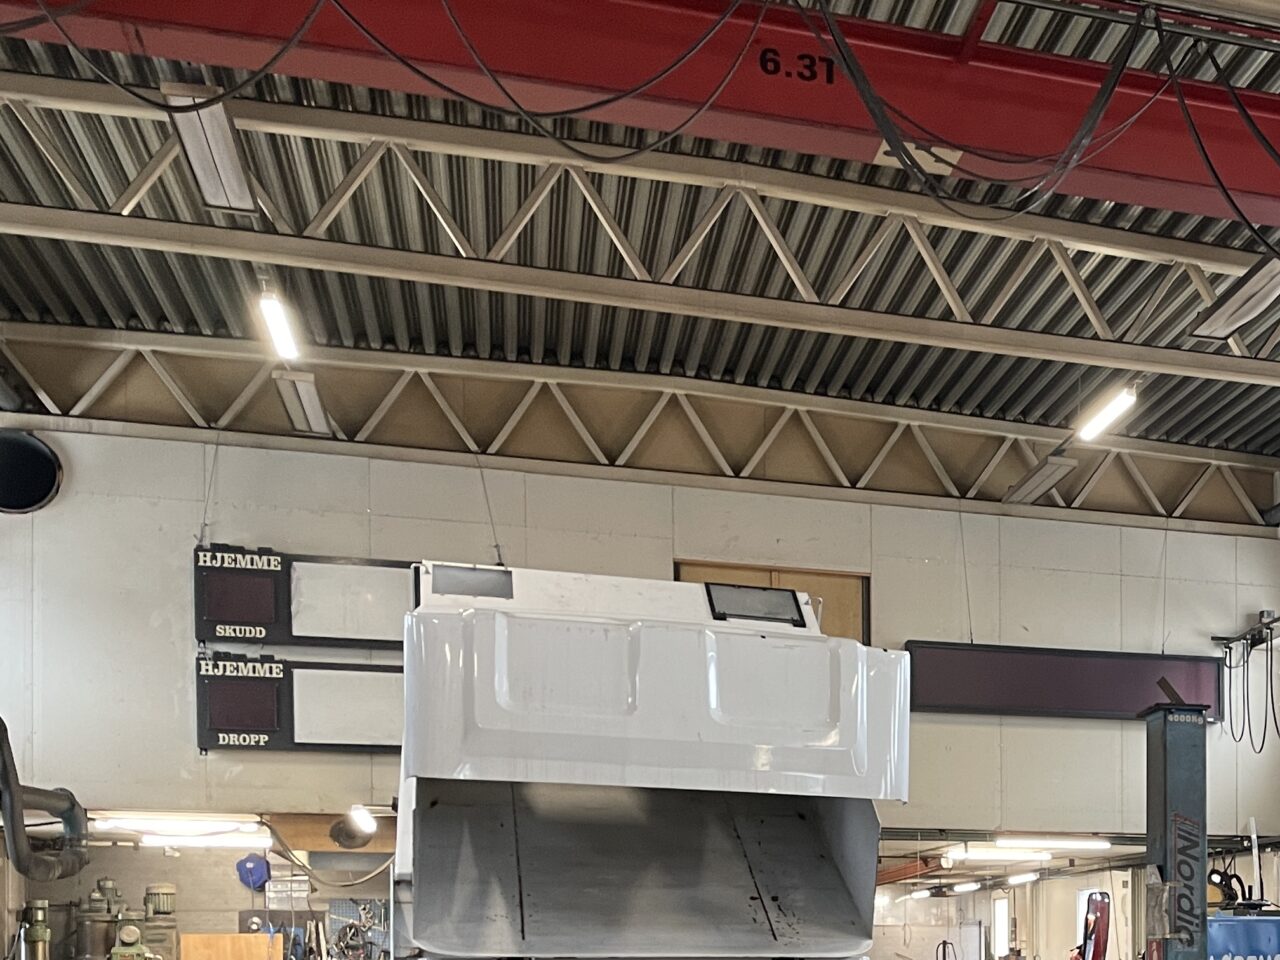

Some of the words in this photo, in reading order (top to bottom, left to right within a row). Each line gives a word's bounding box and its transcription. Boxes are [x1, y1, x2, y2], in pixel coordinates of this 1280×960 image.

[197, 551, 282, 570] HJEMME
[215, 624, 267, 638] SKUDD
[199, 660, 284, 678] HJEMME
[217, 733, 269, 746] DROPP
